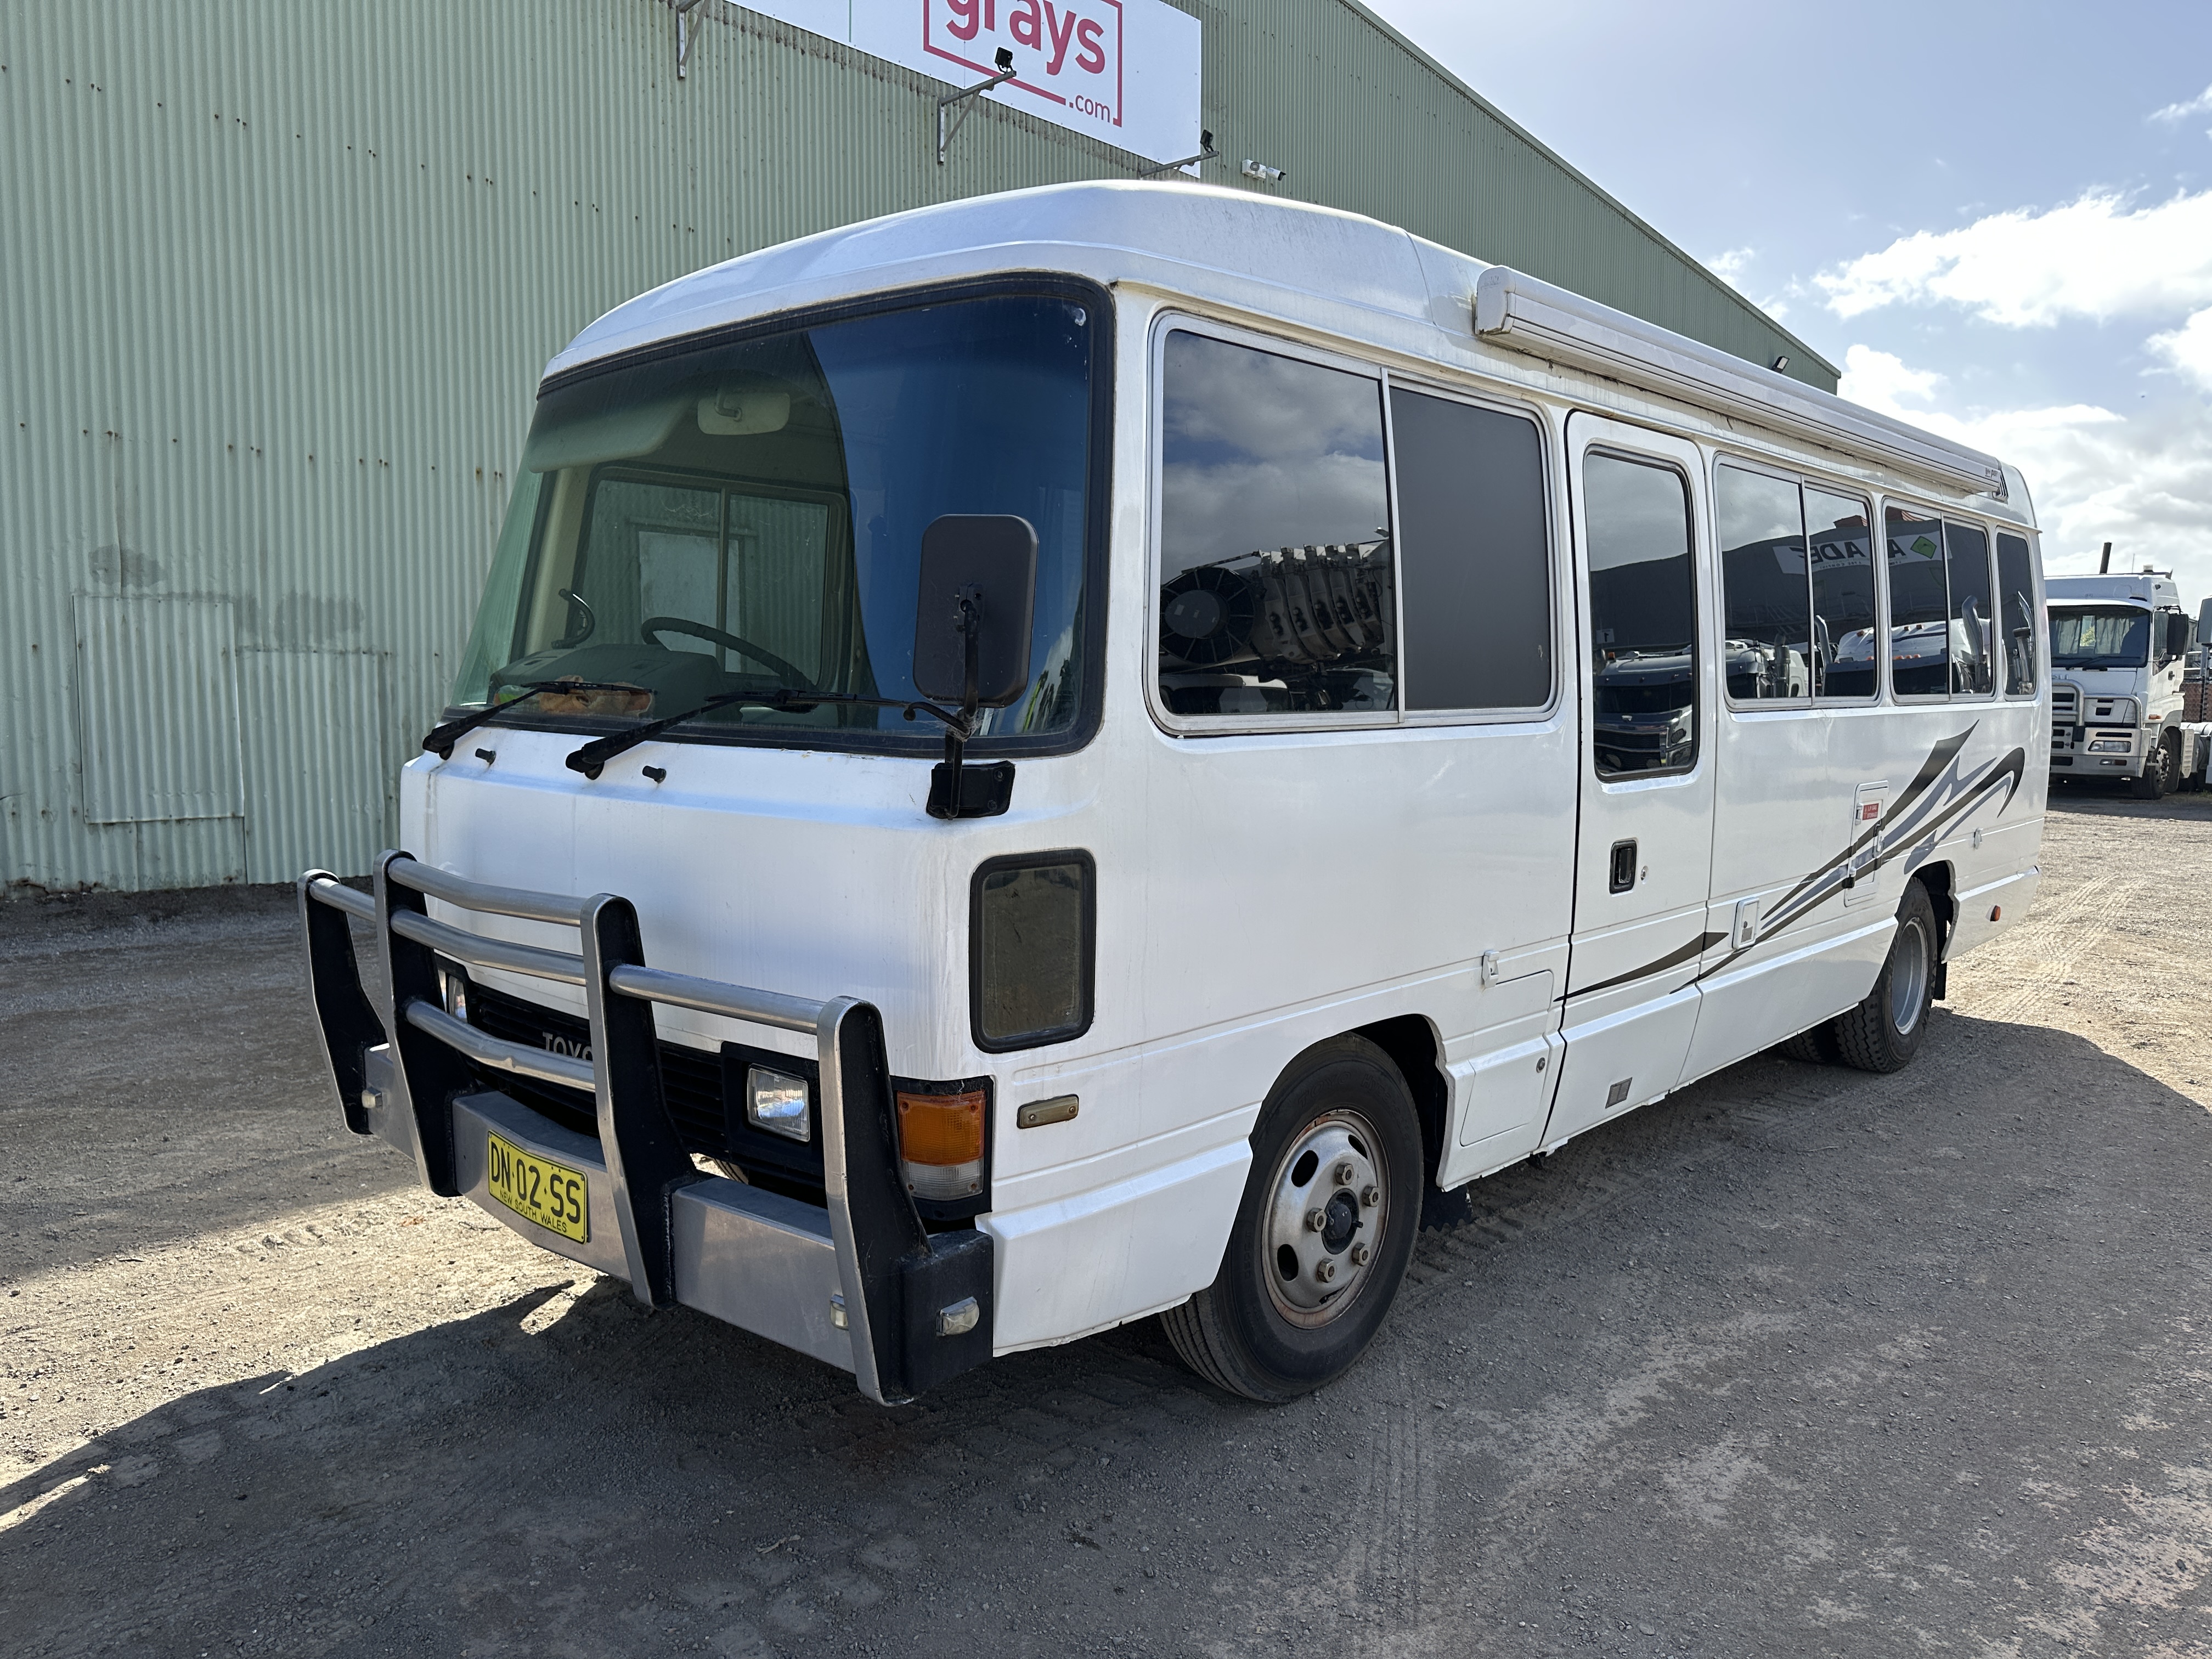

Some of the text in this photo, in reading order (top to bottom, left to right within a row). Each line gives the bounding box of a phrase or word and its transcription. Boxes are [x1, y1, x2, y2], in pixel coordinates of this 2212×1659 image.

[1069, 95, 1110, 123] .com
[542, 1030, 593, 1060] TOYO
[1297, 1071, 1352, 1108] TOYO
[500, 1189, 567, 1233] NEW SOUTH WALES
